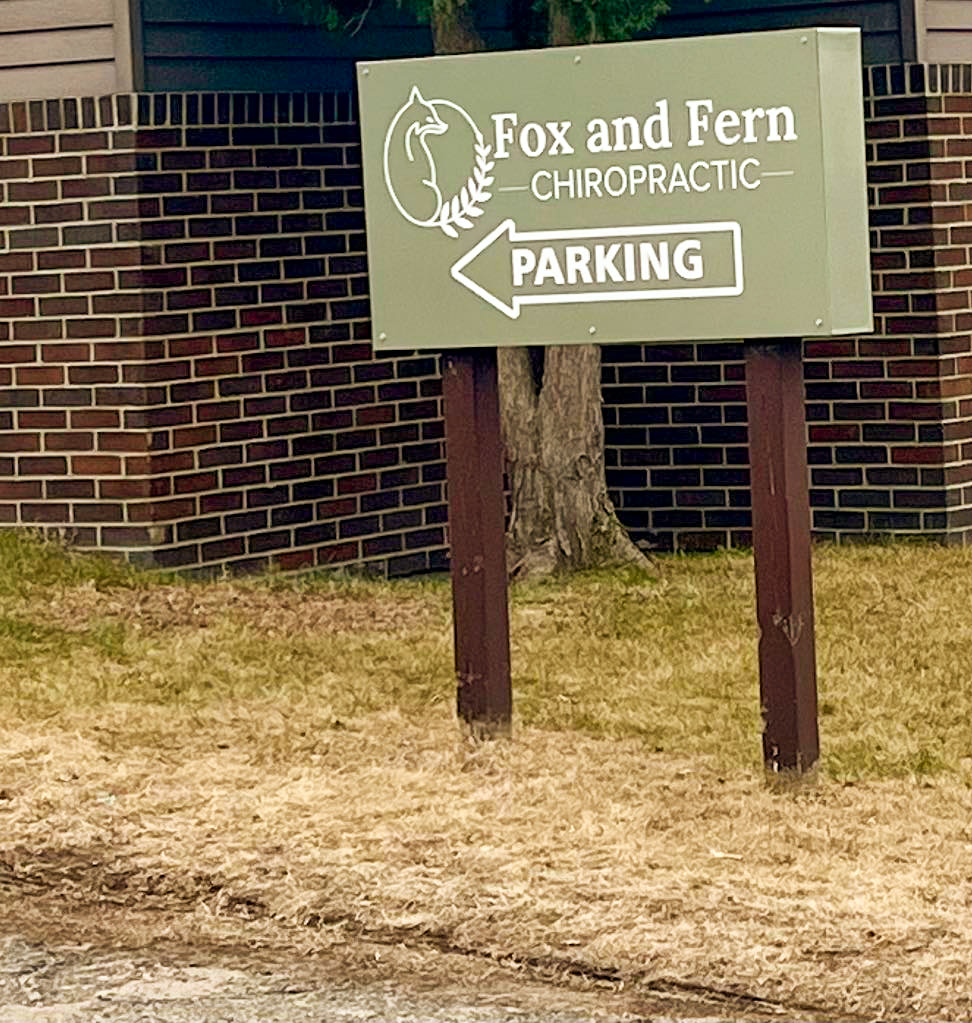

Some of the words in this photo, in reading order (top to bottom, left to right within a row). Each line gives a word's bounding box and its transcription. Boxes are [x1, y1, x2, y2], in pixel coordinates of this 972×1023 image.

[491, 112, 575, 159] Fox
[586, 99, 673, 154] and
[685, 98, 798, 148] Fern
[531, 158, 761, 202] CHIROPRACTIC
[511, 239, 705, 287] PARKING
